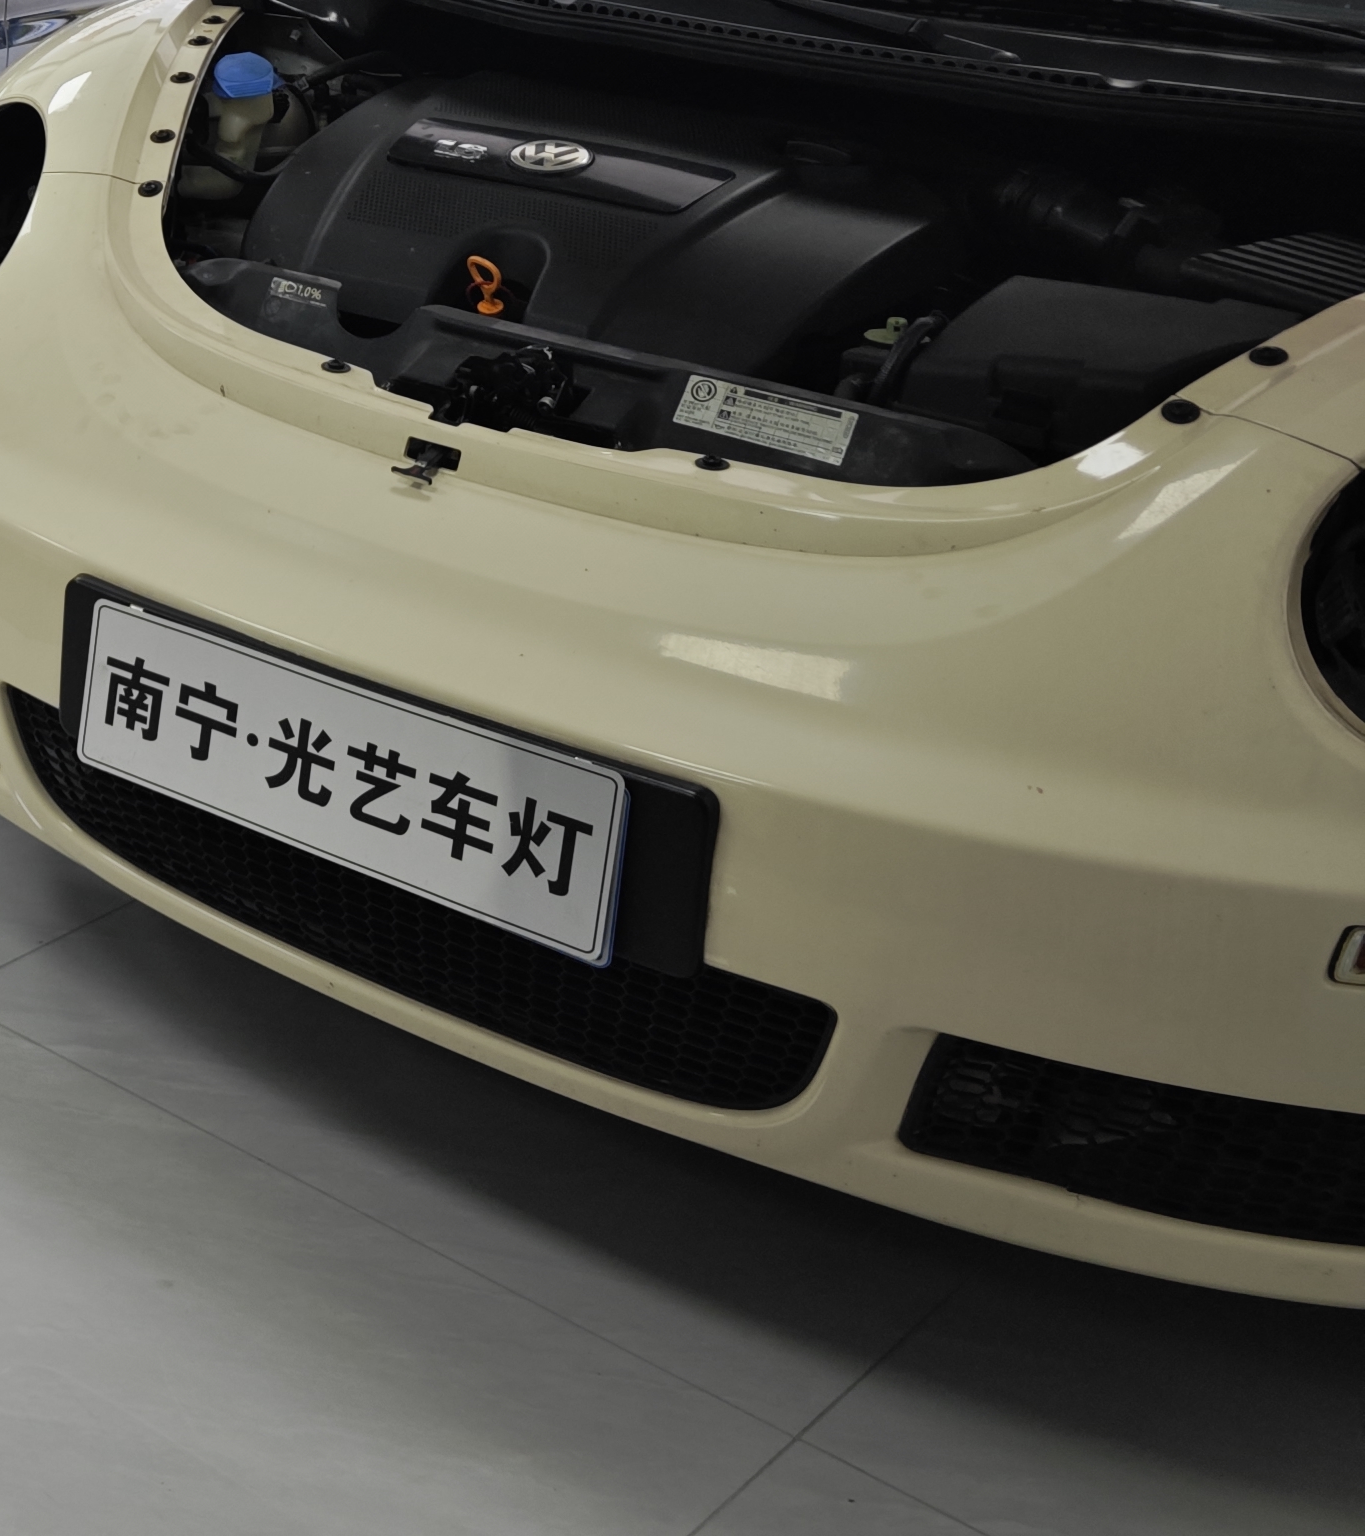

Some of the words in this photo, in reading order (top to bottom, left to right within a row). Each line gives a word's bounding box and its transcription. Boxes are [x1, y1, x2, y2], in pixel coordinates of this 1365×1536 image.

[103, 656, 595, 897] 南宁·光艺车灯
